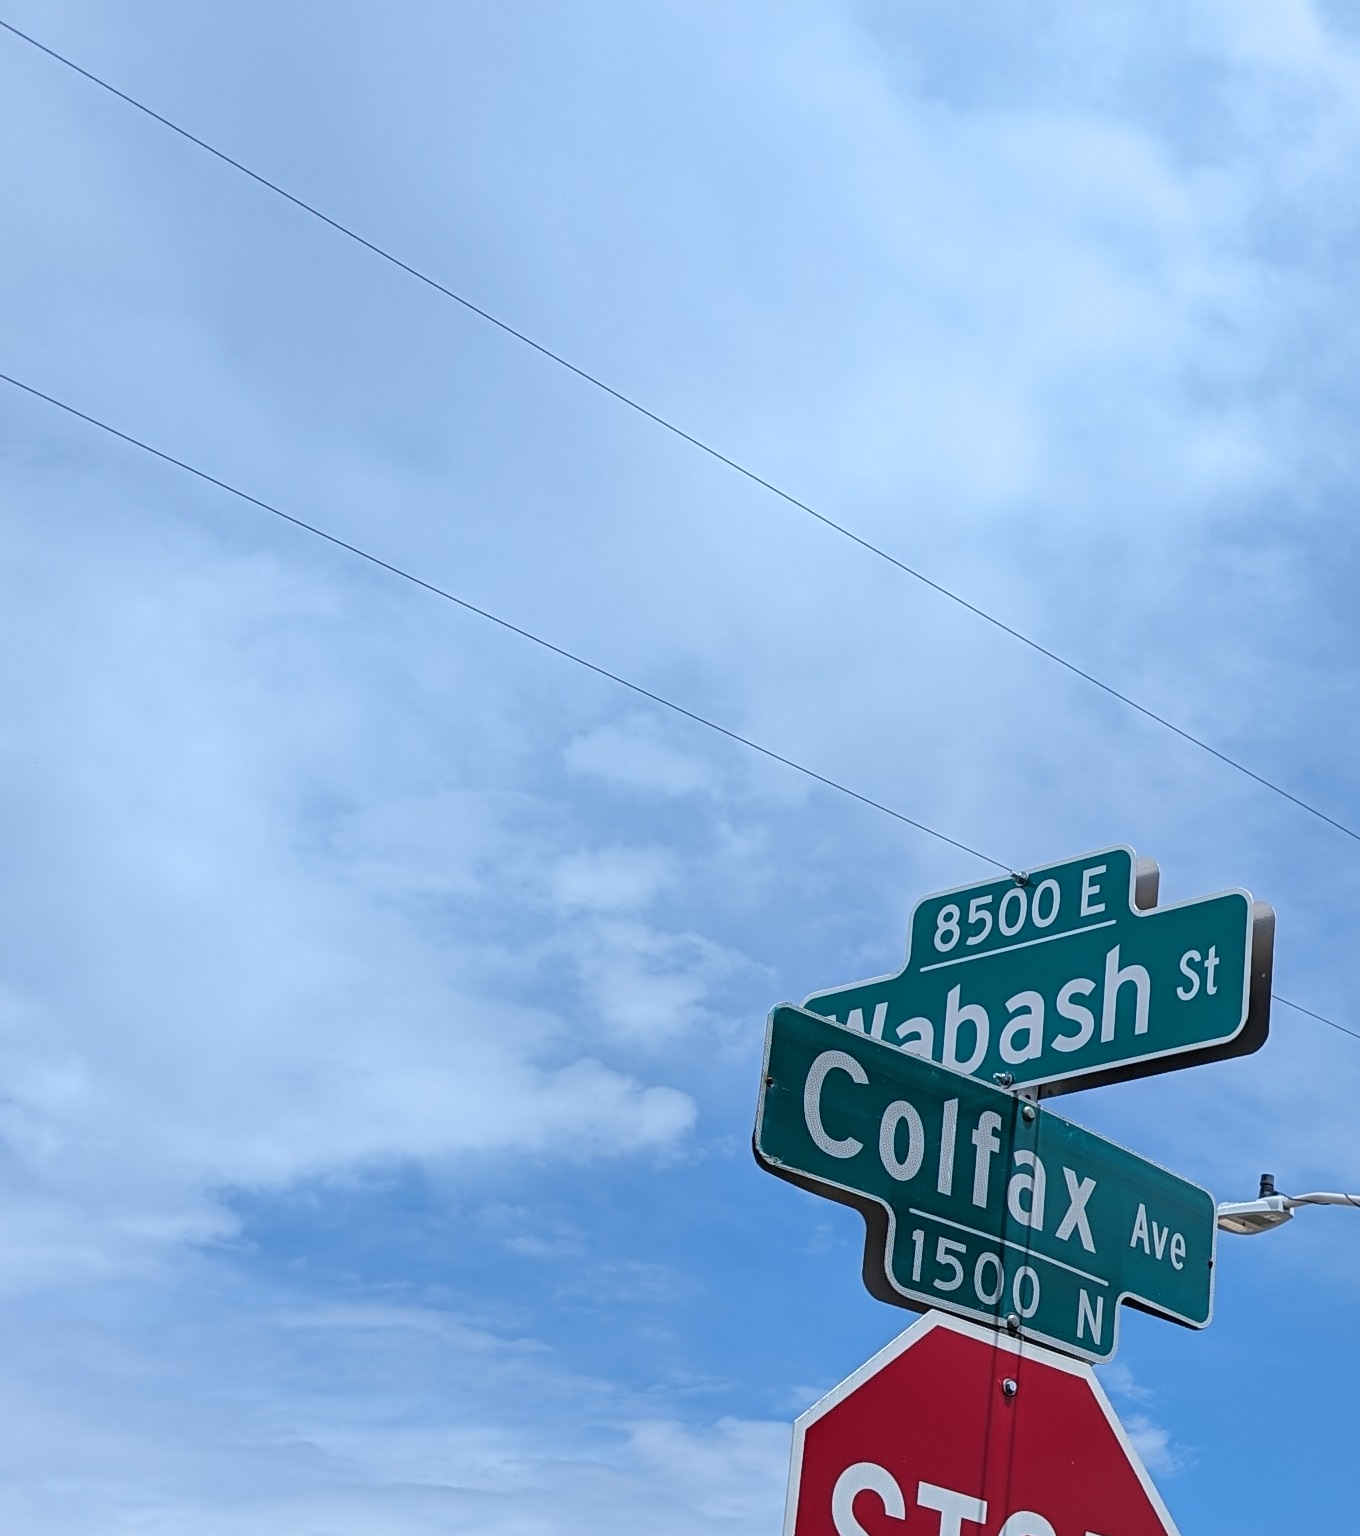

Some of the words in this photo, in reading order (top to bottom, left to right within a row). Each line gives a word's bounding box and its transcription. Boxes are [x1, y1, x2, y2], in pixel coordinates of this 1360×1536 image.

[933, 879, 1061, 952] 8500
[1080, 866, 1107, 917] E
[1176, 945, 1220, 1002] St
[803, 1050, 1097, 1254] Colfax
[1130, 1203, 1187, 1270] Ave
[912, 1229, 1040, 1319] 1500
[1077, 1289, 1104, 1345] N
